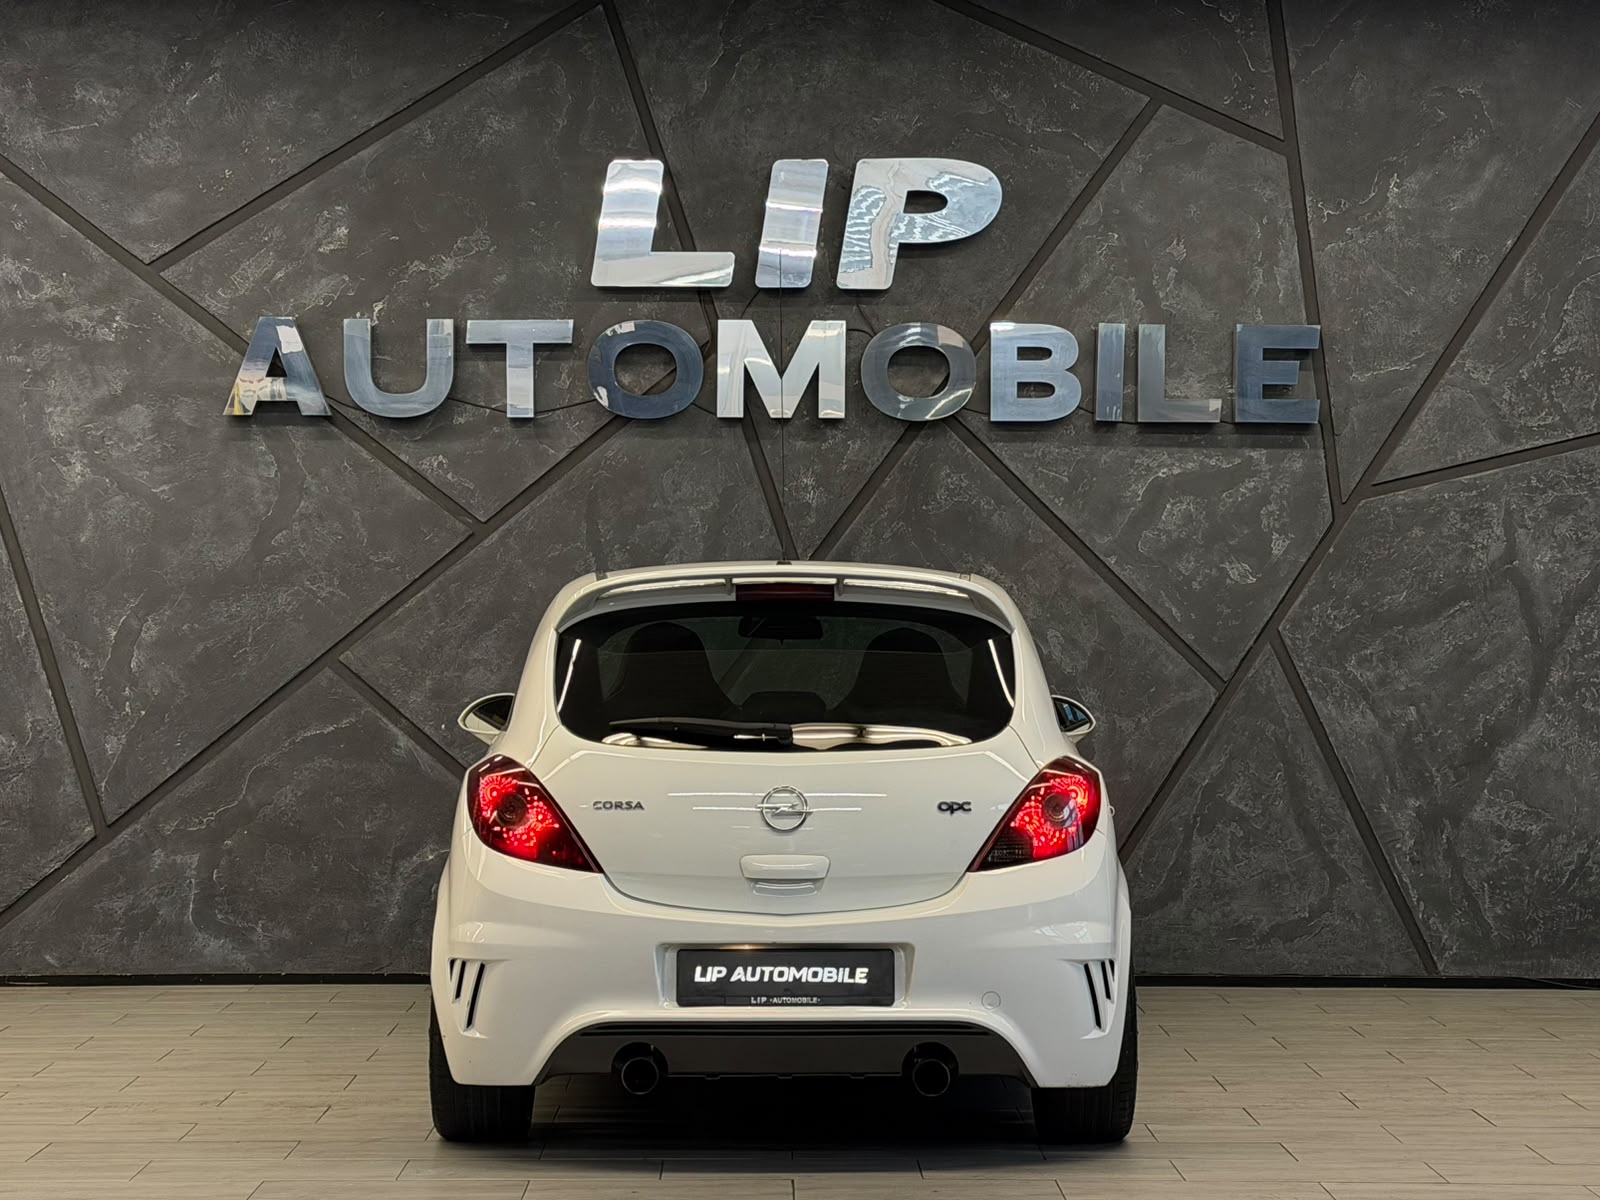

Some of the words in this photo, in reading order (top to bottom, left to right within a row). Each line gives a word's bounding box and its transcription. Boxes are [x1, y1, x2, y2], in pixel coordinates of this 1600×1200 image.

[591, 158, 1003, 290] LIP
[223, 316, 1321, 424] AUTOMOBILE
[593, 801, 645, 811] CORSA
[694, 966, 727, 982] LIP
[730, 967, 869, 984] AUTOMOBILE
[751, 996, 767, 1004] LIP
